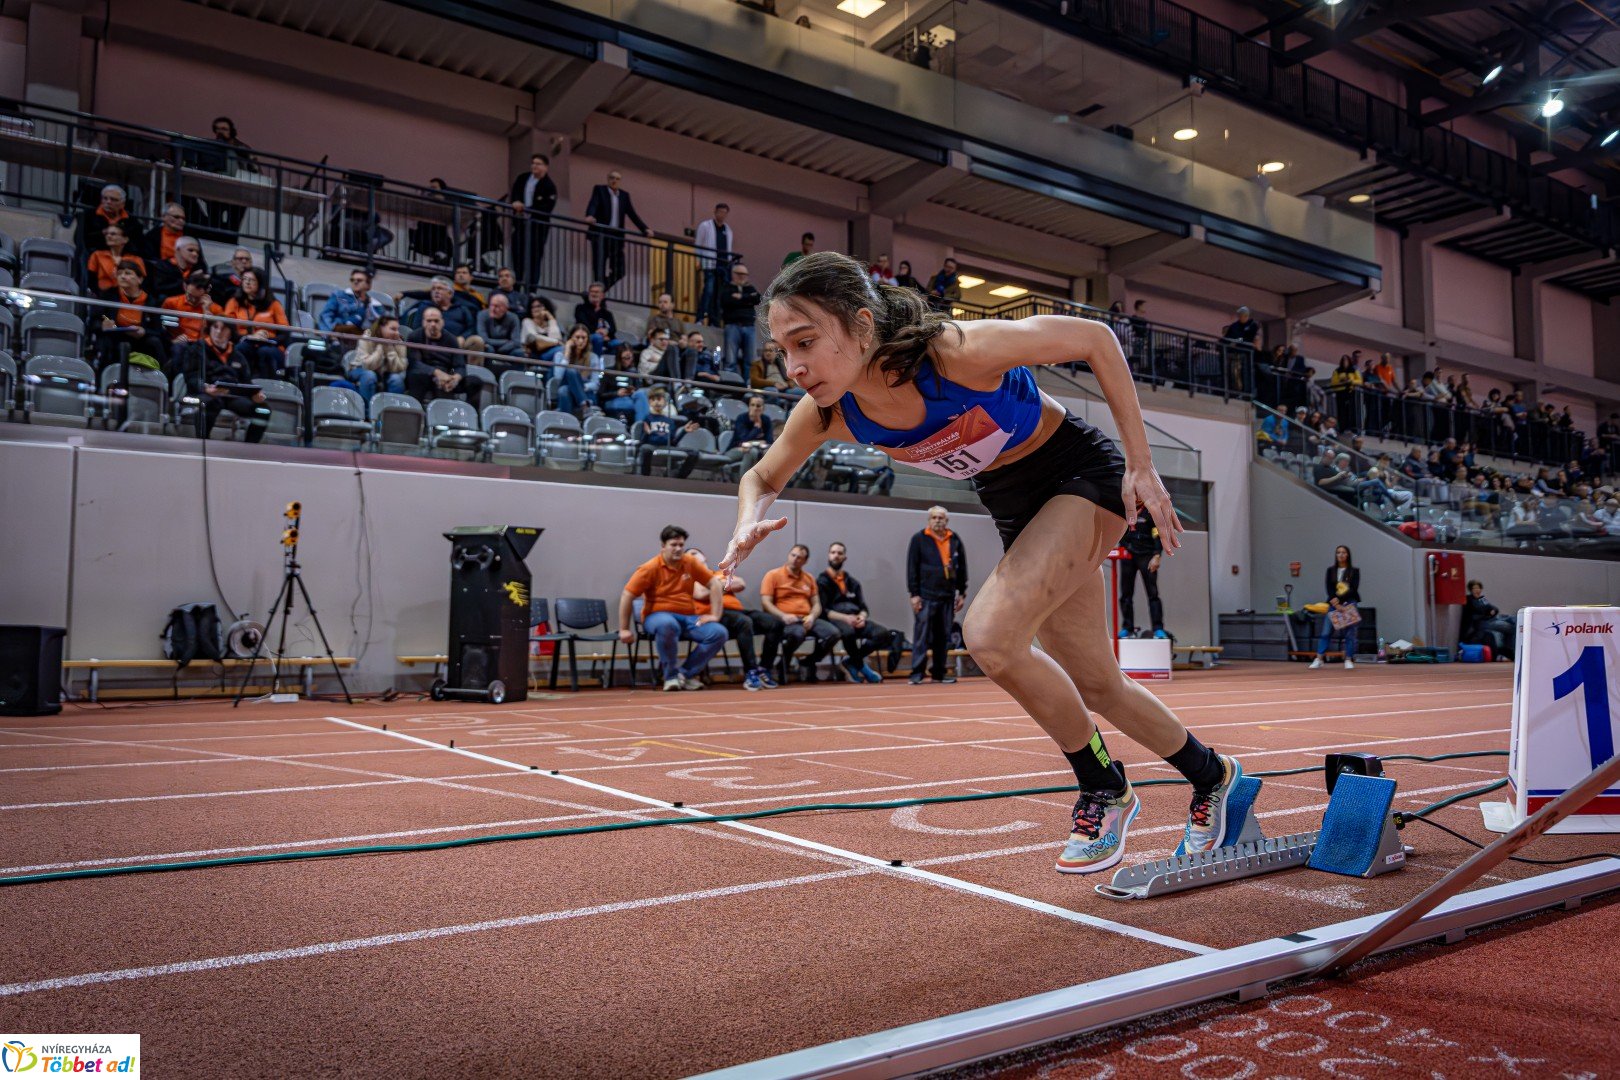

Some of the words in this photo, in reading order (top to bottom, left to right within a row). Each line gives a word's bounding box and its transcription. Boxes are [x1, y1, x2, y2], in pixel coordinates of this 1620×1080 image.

[933, 449, 981, 474] 151
[1565, 622, 1614, 636] polanik
[1552, 645, 1615, 772] 1
[665, 765, 821, 791] 3
[1082, 830, 1119, 860] HOKA
